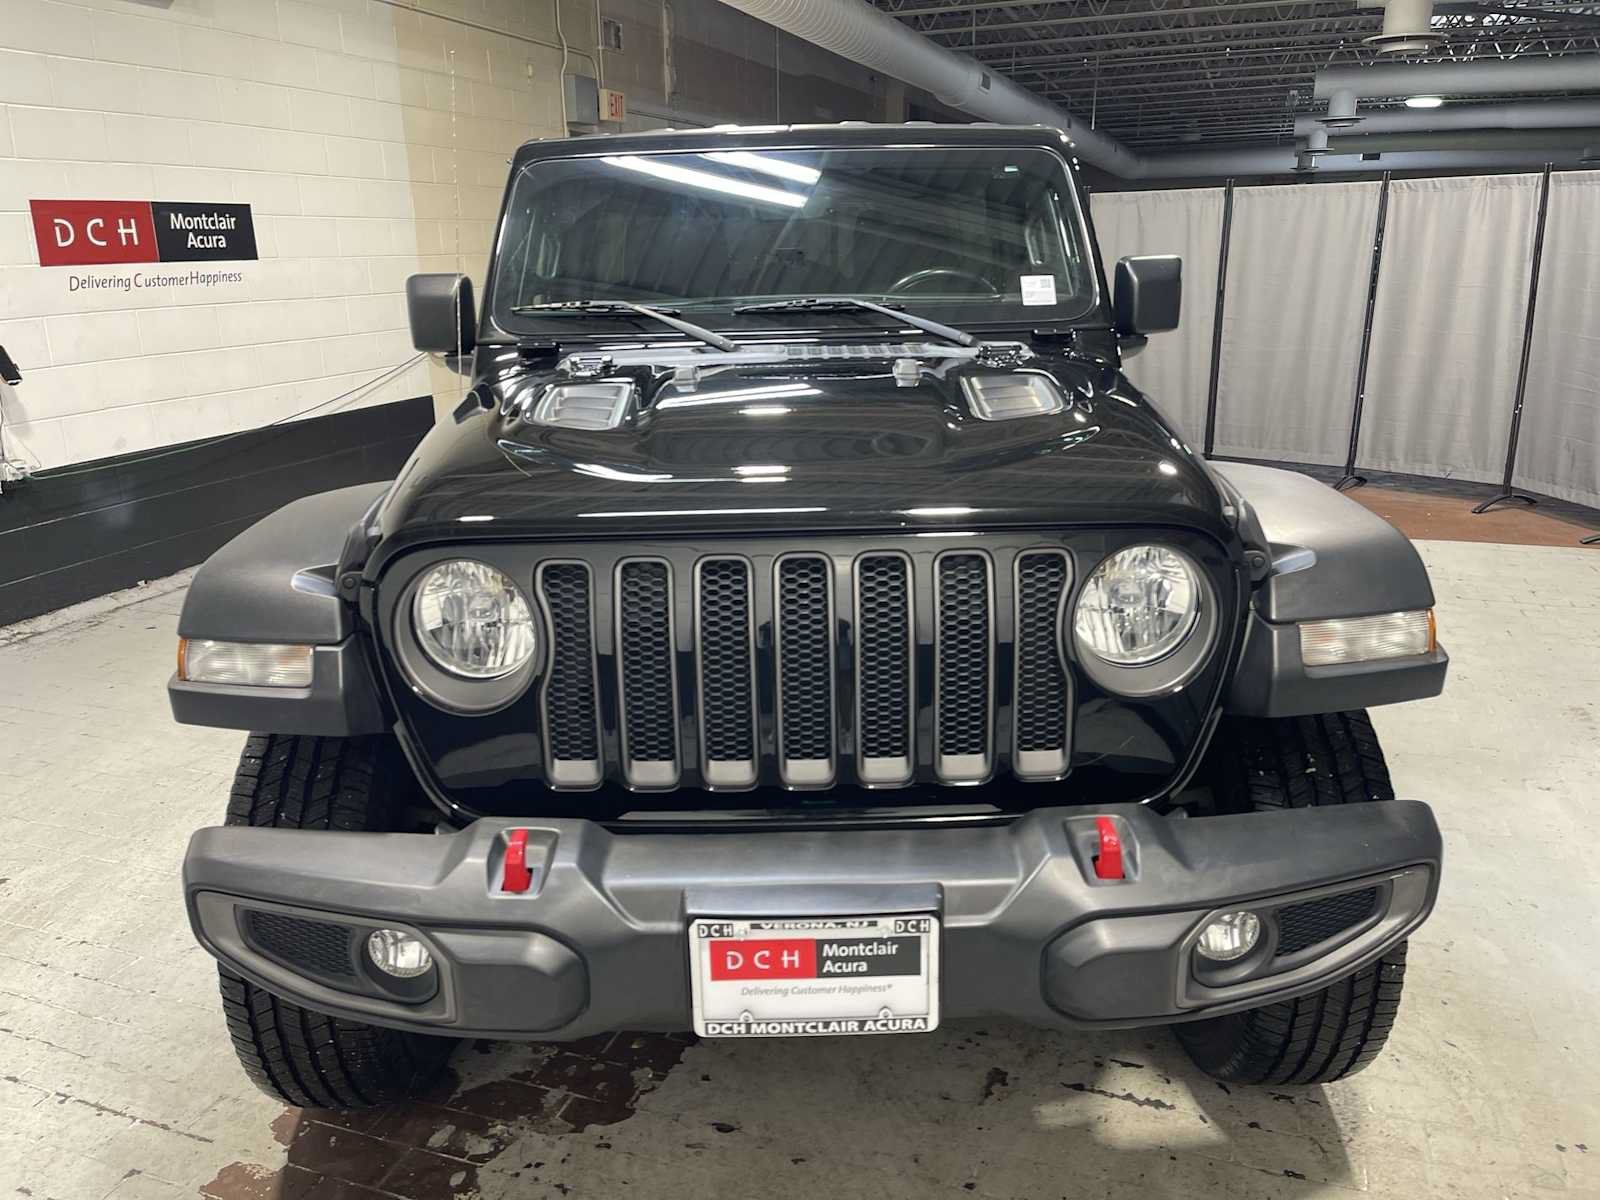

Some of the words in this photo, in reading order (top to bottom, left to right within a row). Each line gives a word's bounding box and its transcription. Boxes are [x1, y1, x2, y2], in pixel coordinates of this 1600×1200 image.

[170, 213, 236, 230] Montclair
[187, 232, 227, 249] Acura
[69, 275, 131, 291] Delivering
[133, 272, 189, 288] Customer
[190, 271, 242, 286] Happiness
[699, 925, 733, 937] DCH
[896, 920, 930, 933] DCH
[822, 942, 899, 957] Montclair
[726, 950, 800, 970] DCH
[822, 959, 868, 973] Acura
[741, 986, 790, 997] Delivering
[791, 985, 836, 996] Customer
[707, 1023, 747, 1034] DCH
[750, 1021, 860, 1034] MONTCLAIR
[863, 1019, 926, 1032] ACURA
